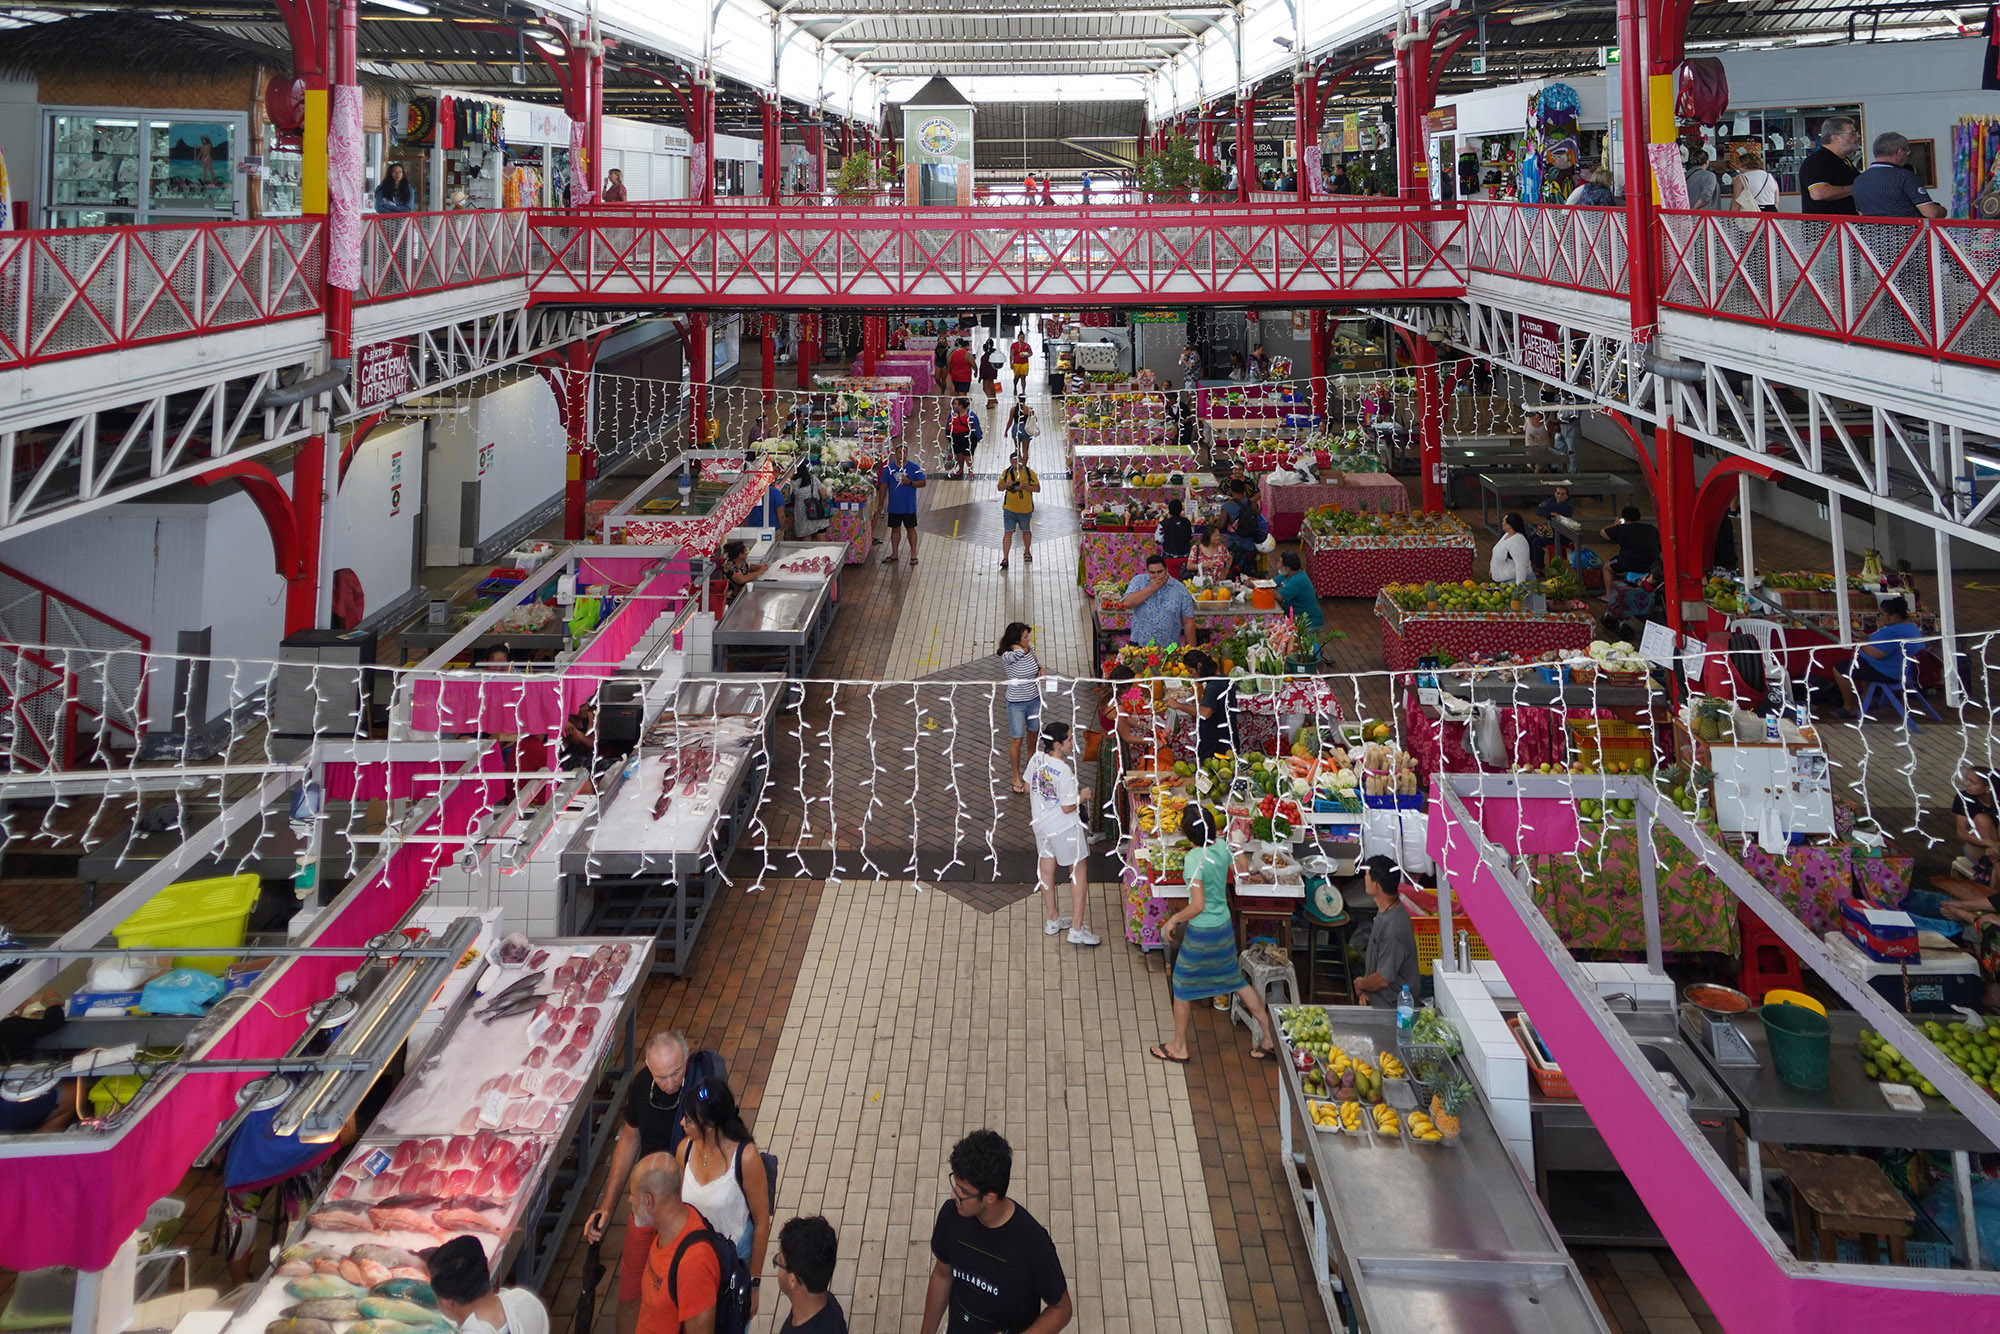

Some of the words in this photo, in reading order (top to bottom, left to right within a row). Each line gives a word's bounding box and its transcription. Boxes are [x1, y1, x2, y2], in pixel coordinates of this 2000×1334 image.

[1523, 332, 1557, 358] CAFETERIA
[362, 355, 406, 385] CAFETERIA
[1524, 350, 1557, 376] ARTISANAT
[361, 375, 406, 405] ARTISANAT
[112, 996, 134, 1005] WRAP
[952, 1268, 999, 1296] BILLABONG
